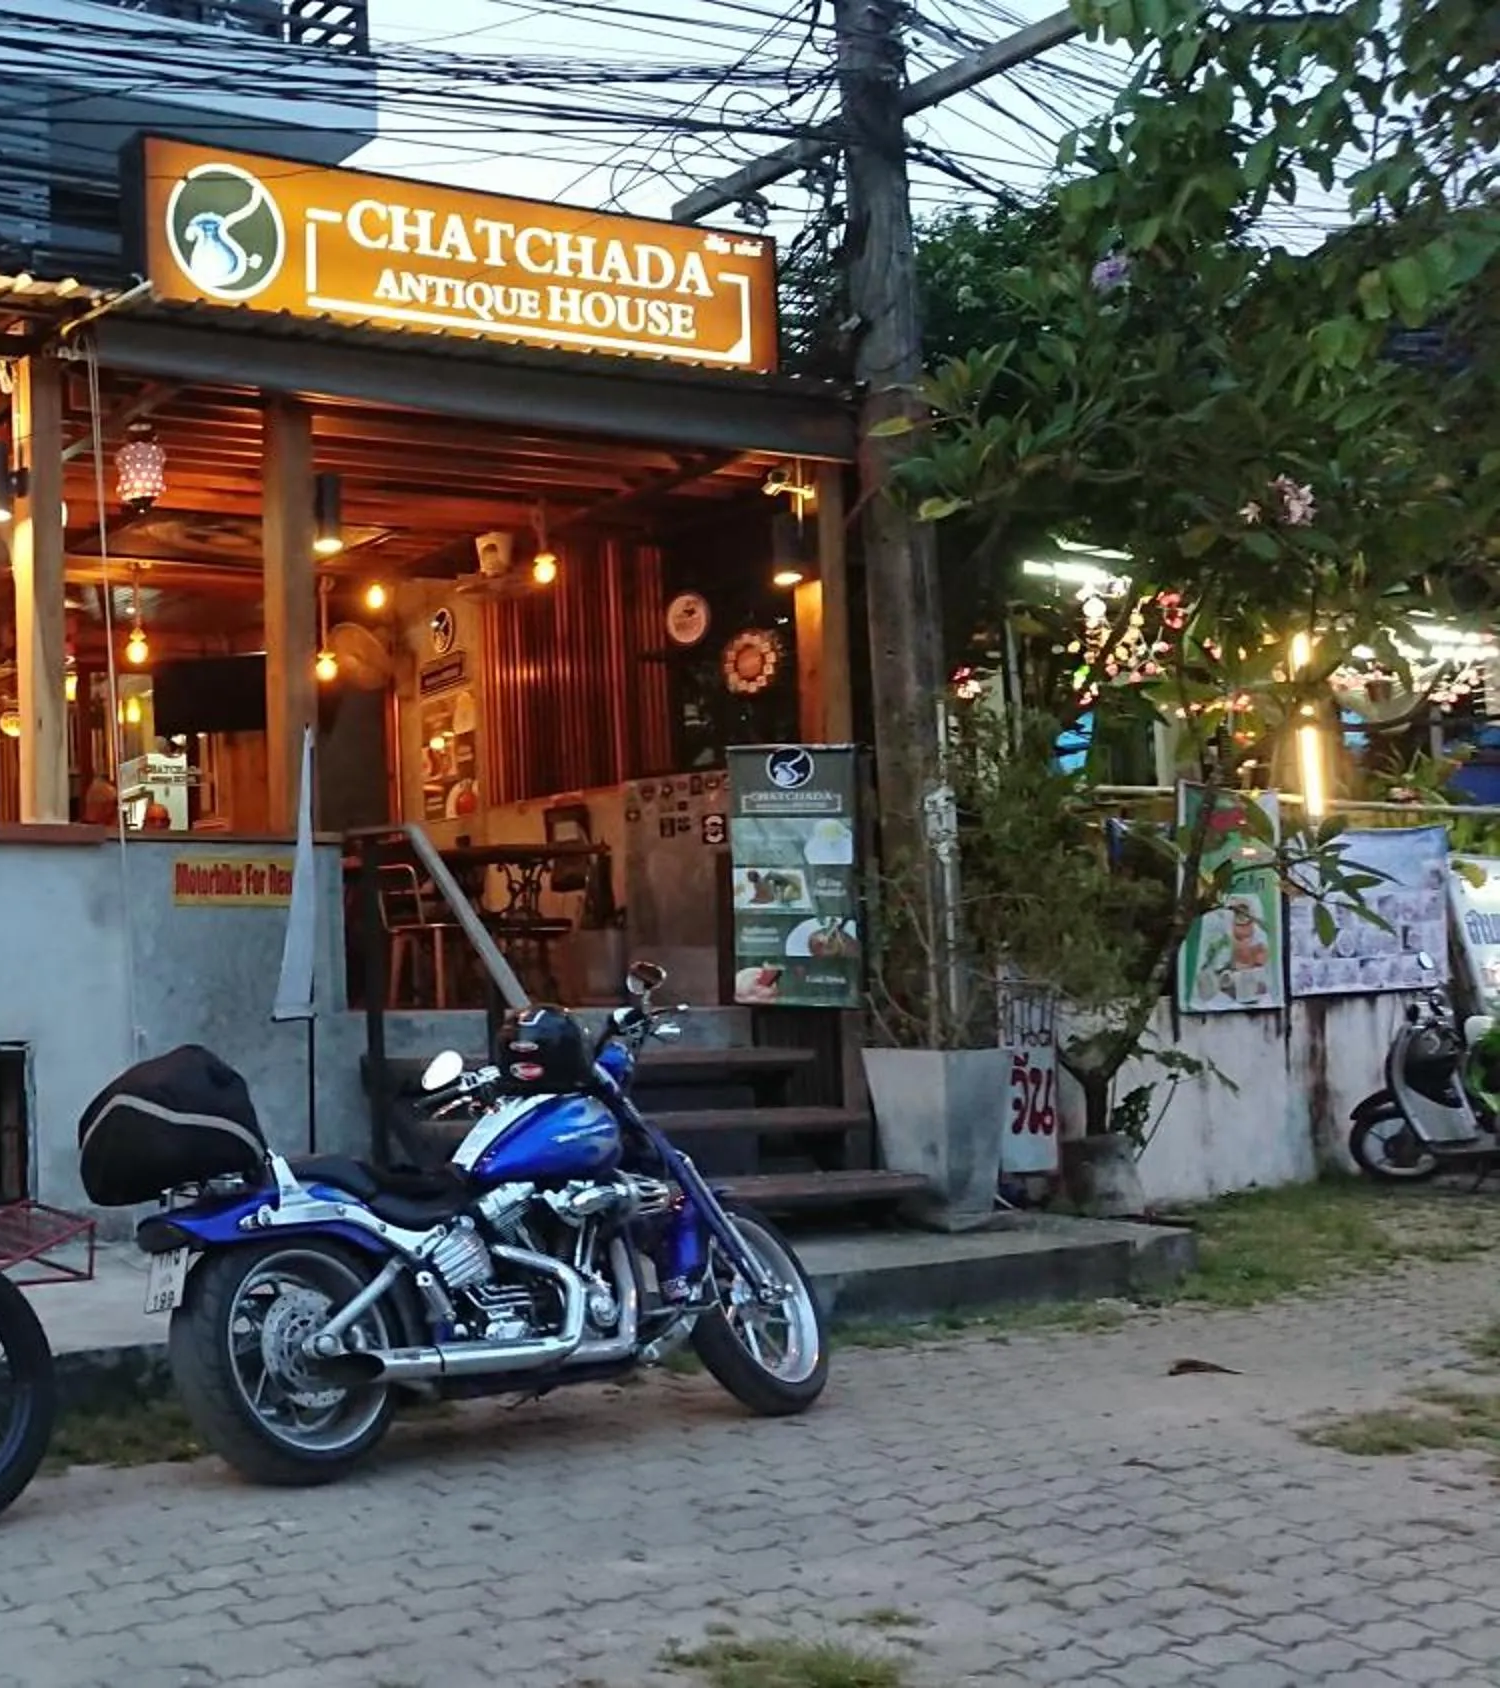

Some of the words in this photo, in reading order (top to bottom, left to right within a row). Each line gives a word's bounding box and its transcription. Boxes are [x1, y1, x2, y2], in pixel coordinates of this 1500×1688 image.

[346, 198, 714, 298] CHATCHADA
[374, 267, 541, 321] ANTIQUE
[546, 284, 697, 340] HOUSE
[175, 863, 242, 896] Motorbike
[246, 863, 267, 896] For
[269, 863, 293, 896] Ren
